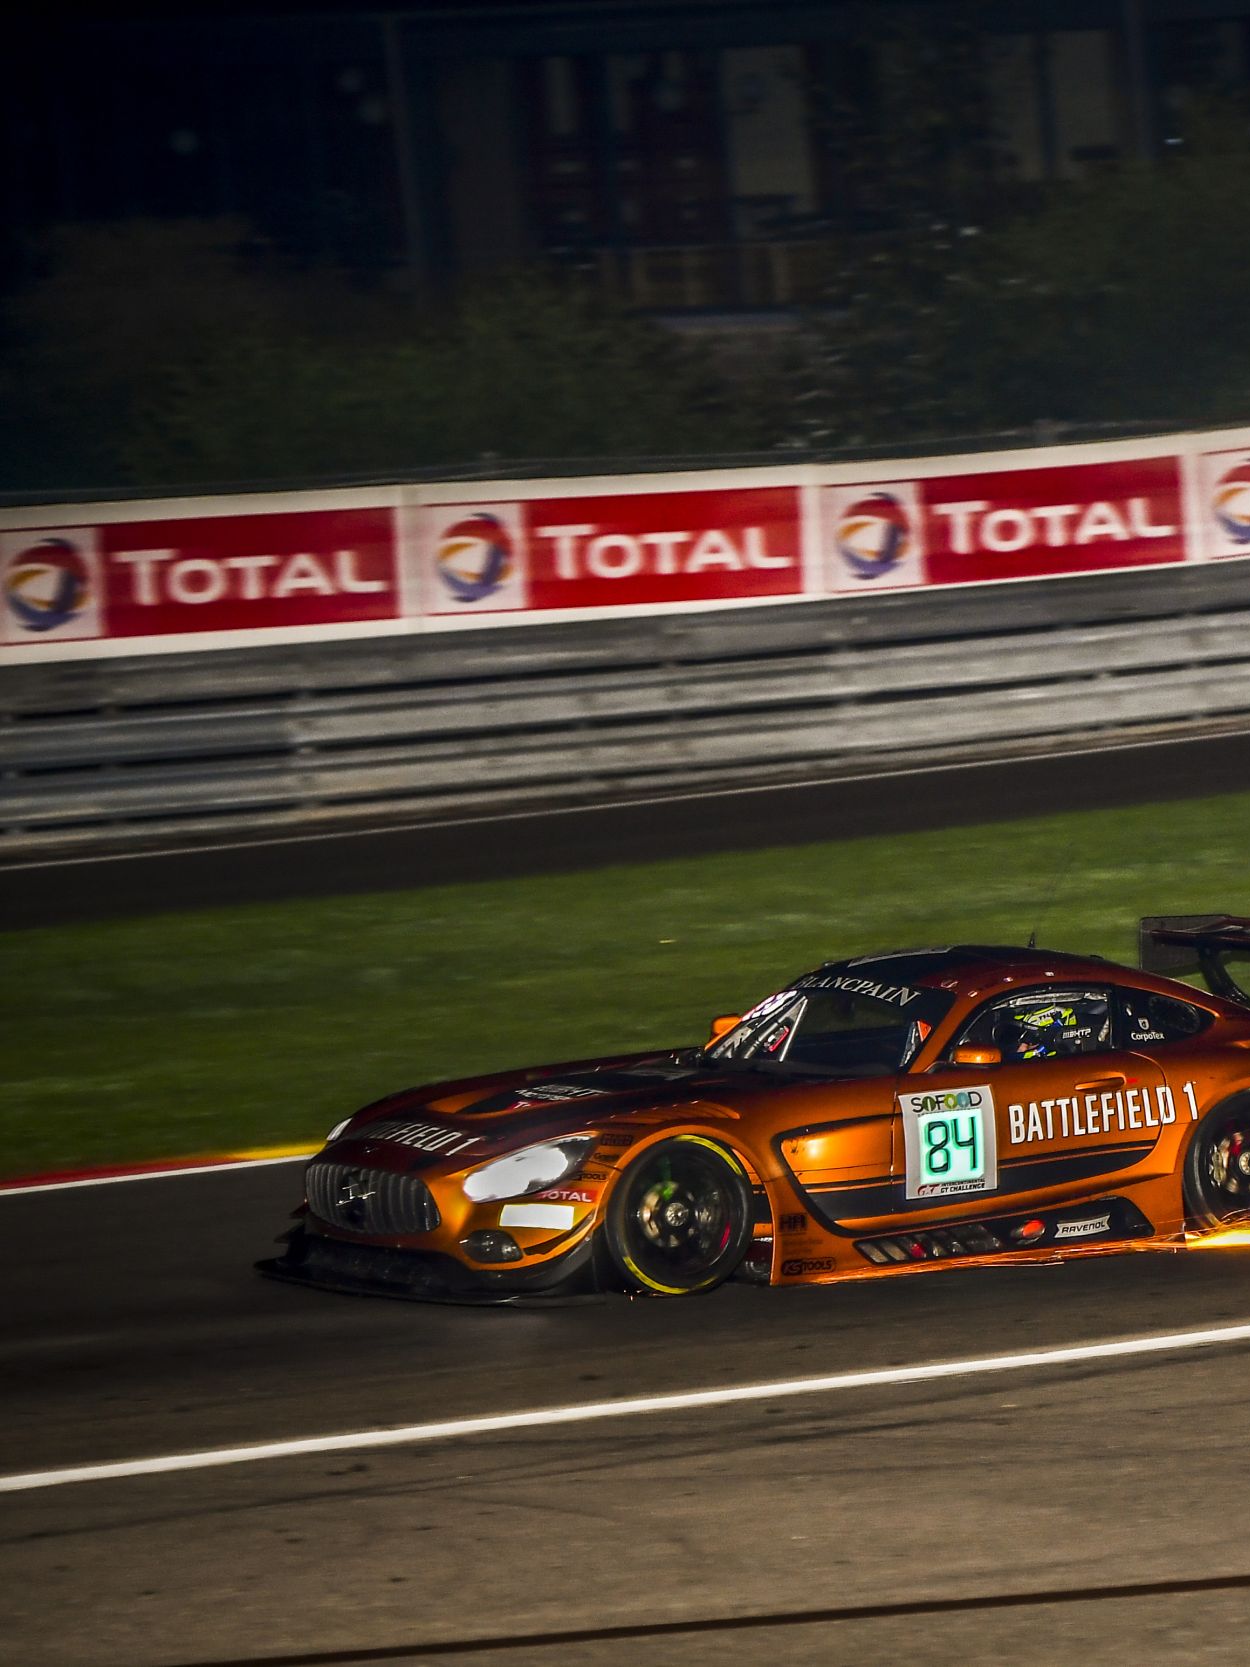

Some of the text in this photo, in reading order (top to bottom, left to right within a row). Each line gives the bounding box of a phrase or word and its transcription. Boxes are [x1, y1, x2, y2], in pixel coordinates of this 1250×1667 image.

[536, 523, 790, 580] TOTAL
[932, 497, 1174, 555] TOTAL
[115, 548, 388, 606] TOTAL
[796, 976, 922, 1007] BLANCPAIN
[1131, 1032, 1165, 1042] CorpoTex
[1008, 1081, 1199, 1144] BATTLEFIELD 1
[926, 1116, 978, 1174] 84
[950, 1182, 985, 1192] CHALLENGE
[1061, 1221, 1105, 1233] RAVENOL
